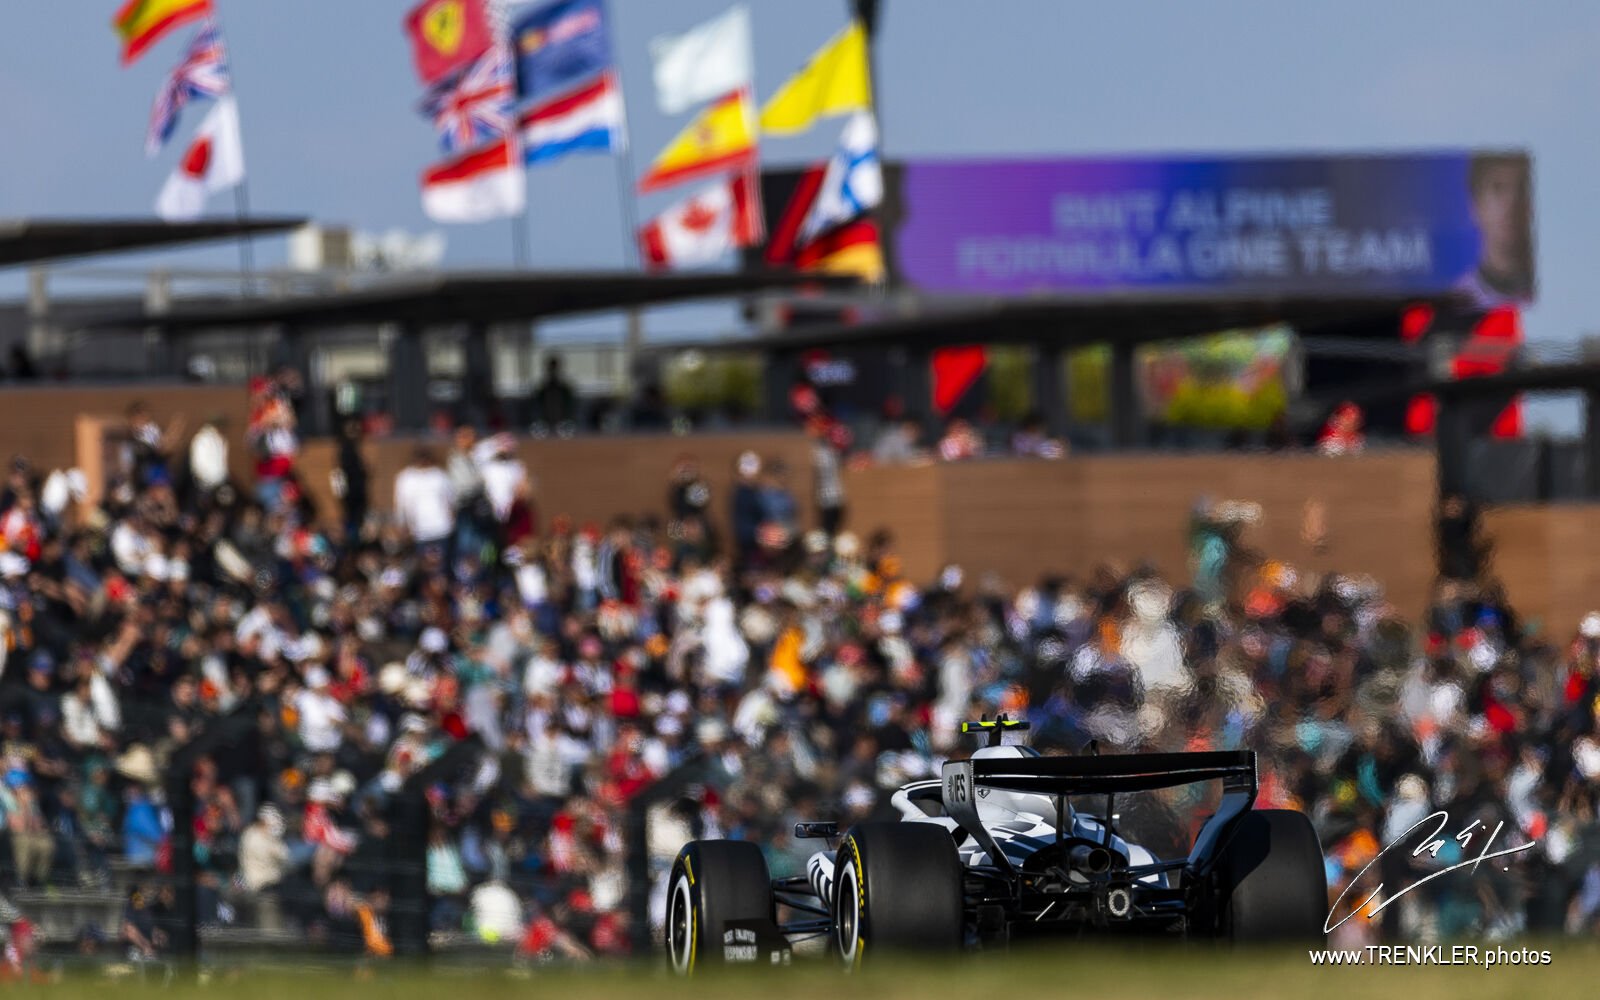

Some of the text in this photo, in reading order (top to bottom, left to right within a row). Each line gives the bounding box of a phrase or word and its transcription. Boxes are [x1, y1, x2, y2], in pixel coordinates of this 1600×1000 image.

[1168, 189, 1333, 228] ALPINE
[957, 229, 1430, 276] FORMULA ONE TEAM
